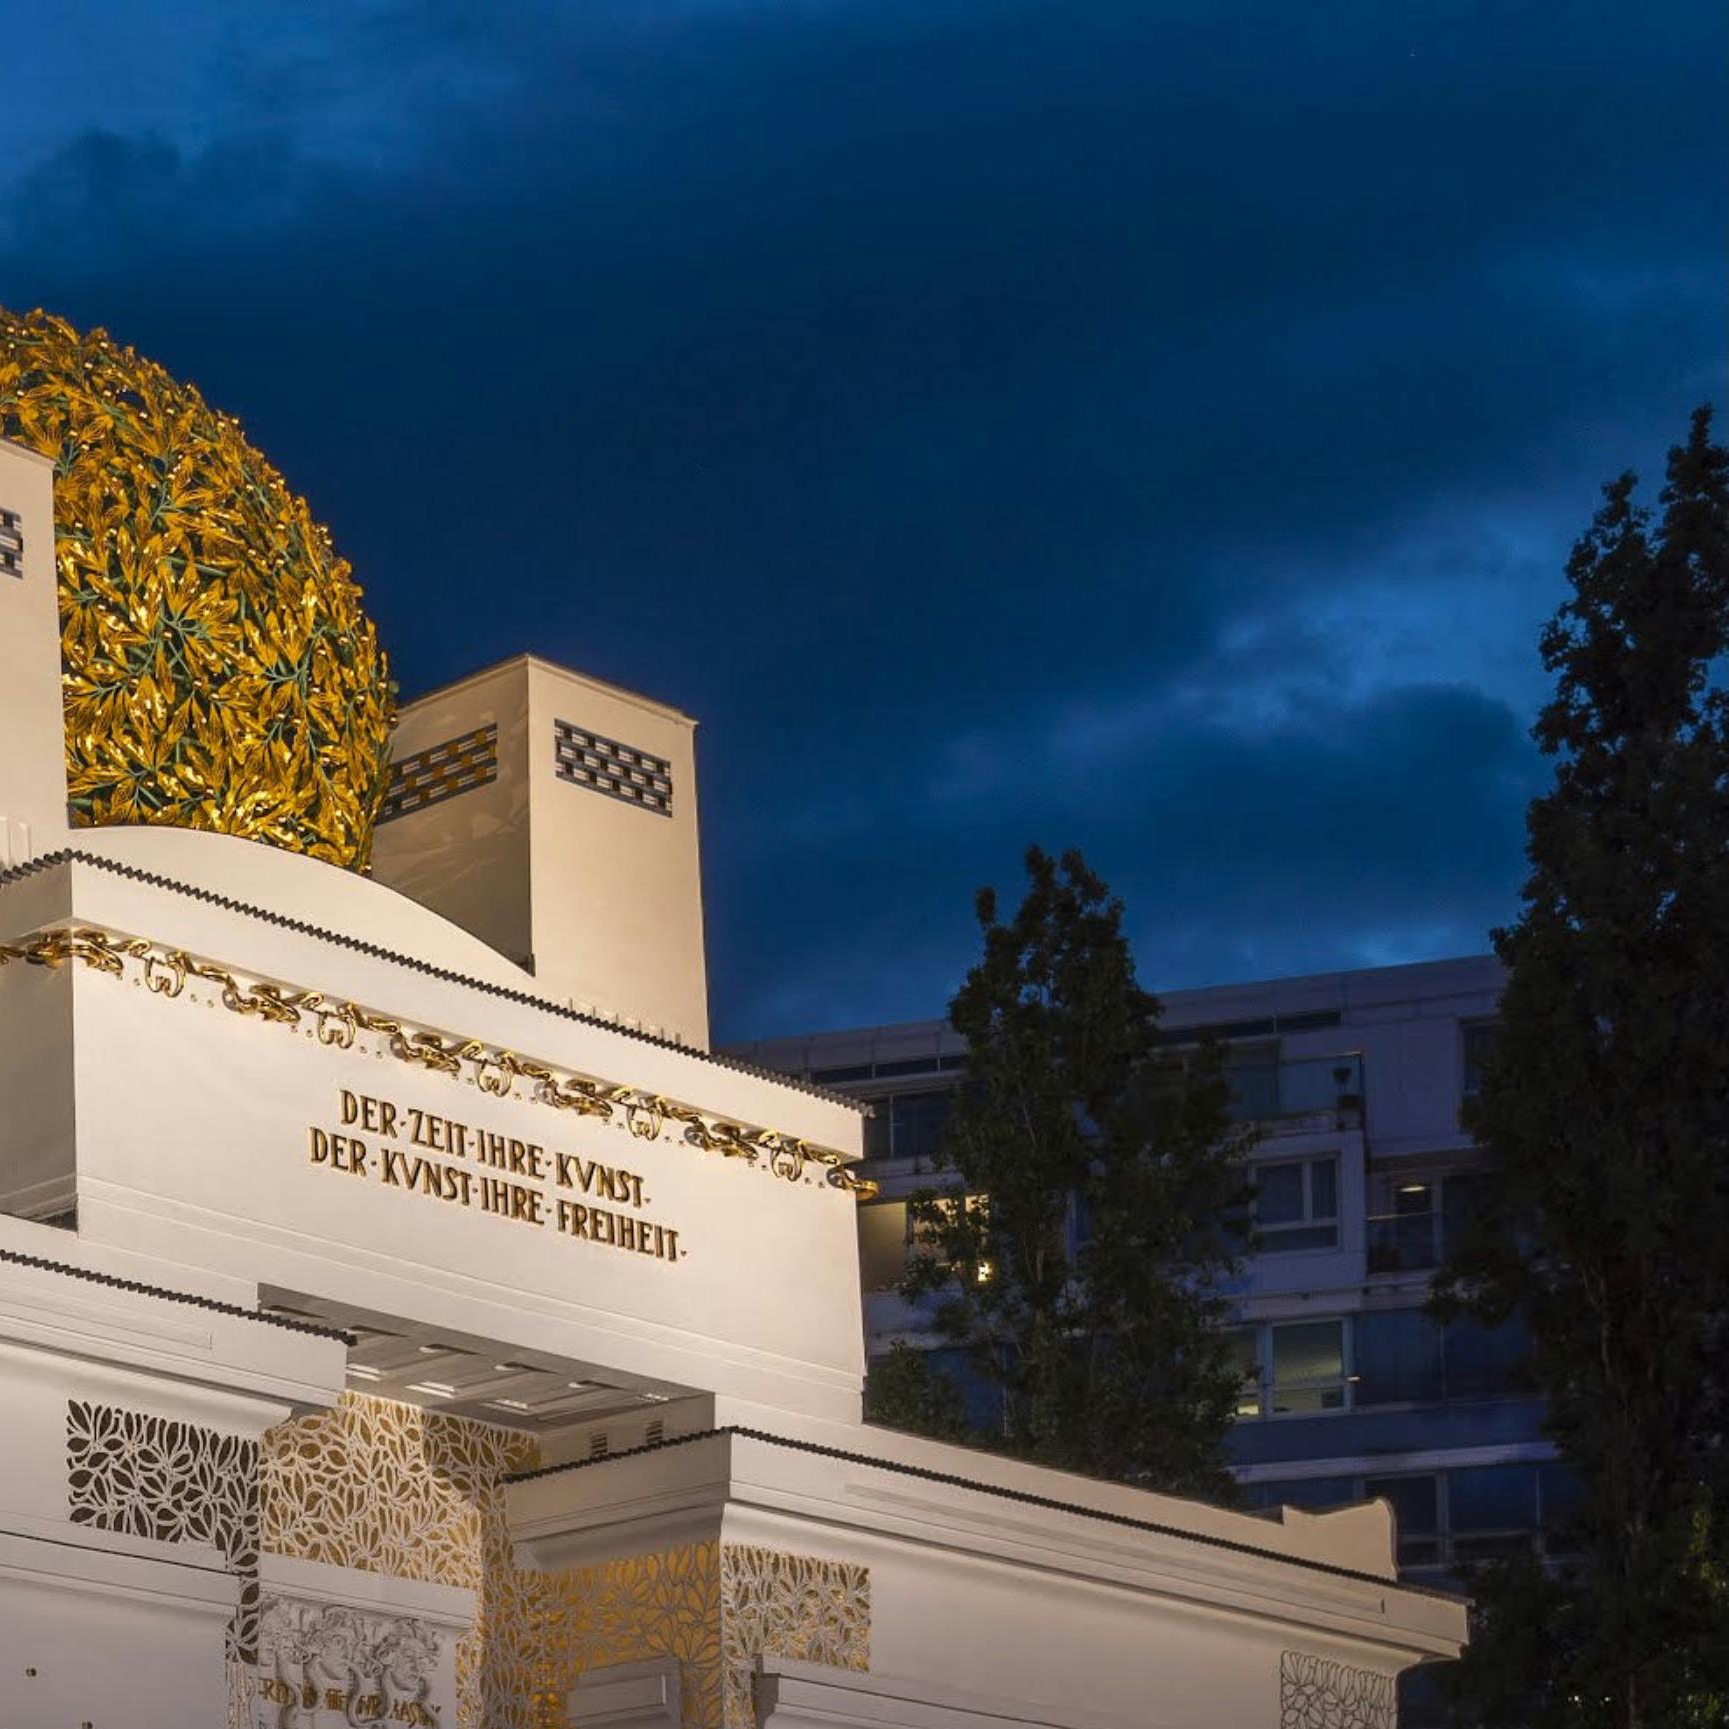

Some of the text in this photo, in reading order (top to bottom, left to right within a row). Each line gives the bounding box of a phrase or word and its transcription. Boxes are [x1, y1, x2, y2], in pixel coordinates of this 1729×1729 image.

[310, 1126, 367, 1176] DER
[381, 1148, 472, 1206] KVNST
[479, 1177, 545, 1225] IHRE
[340, 1089, 397, 1139] DER
[407, 1108, 468, 1159] ZEIT
[476, 1129, 545, 1179] IHRE
